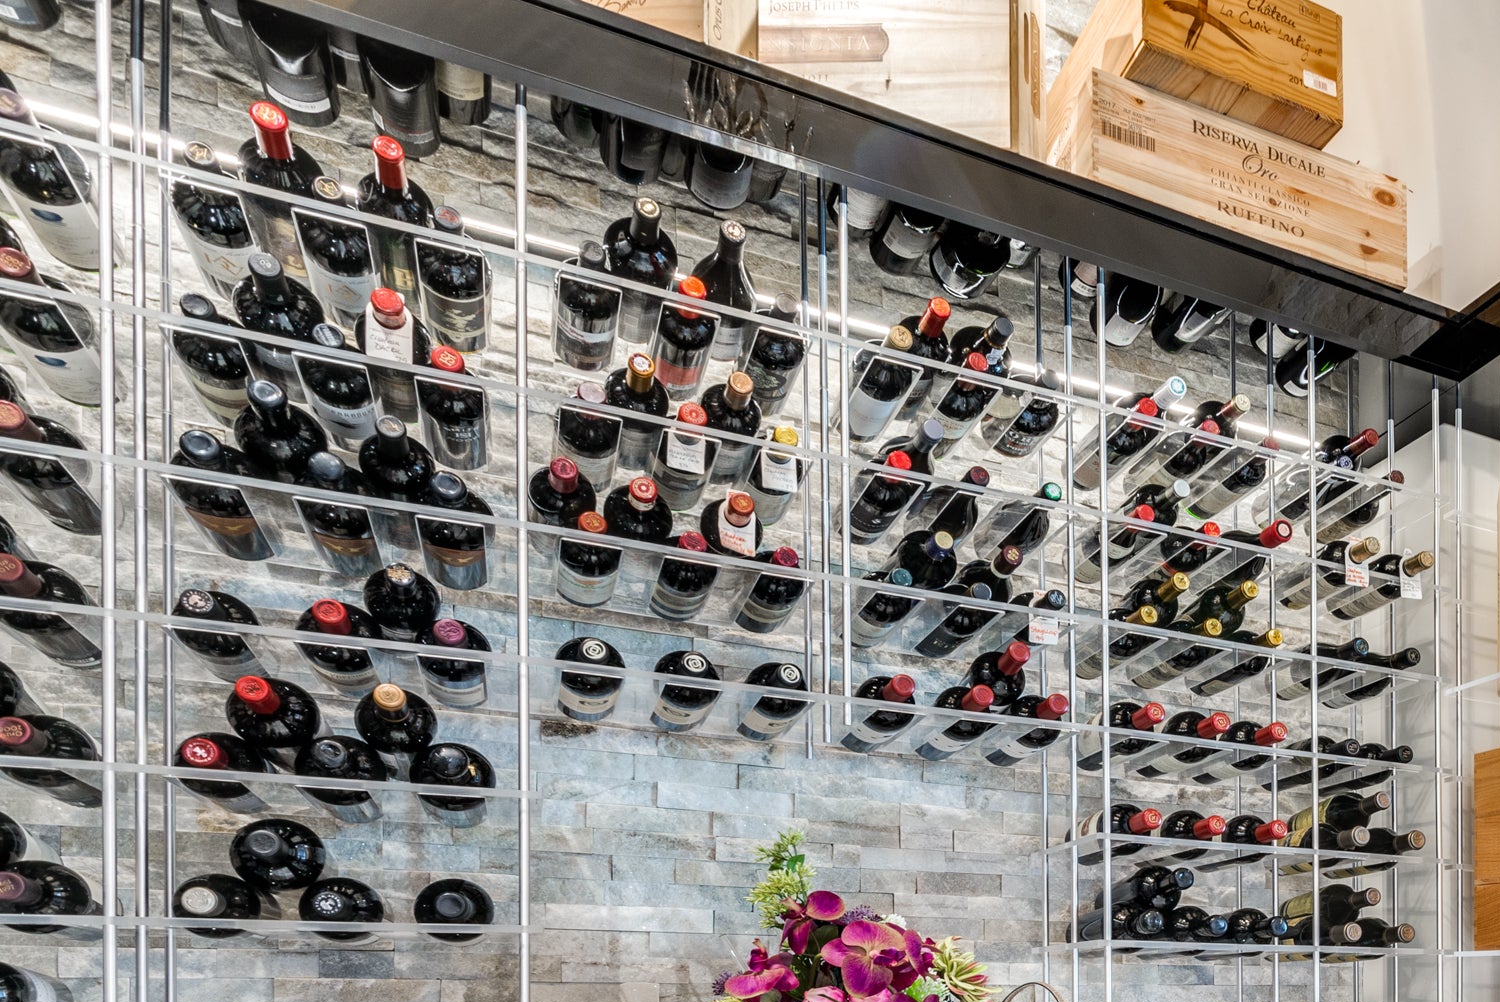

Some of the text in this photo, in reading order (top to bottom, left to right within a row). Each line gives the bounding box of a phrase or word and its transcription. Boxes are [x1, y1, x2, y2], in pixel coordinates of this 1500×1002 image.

[769, 0, 811, 15] JOSEPH
[1220, 4, 1234, 18] La
[1238, 11, 1271, 34] Croix
[764, 34, 872, 51] NSIGNIA
[1289, 74, 1309, 89] 201
[1192, 119, 1326, 178] RISERVA DUCALE
[1242, 154, 1280, 180] Oro
[1210, 167, 1311, 207] CHIANTI CLASSICO
[1210, 177, 1311, 218] GRAN SELZIONE
[1217, 199, 1305, 238] RUFFINO
